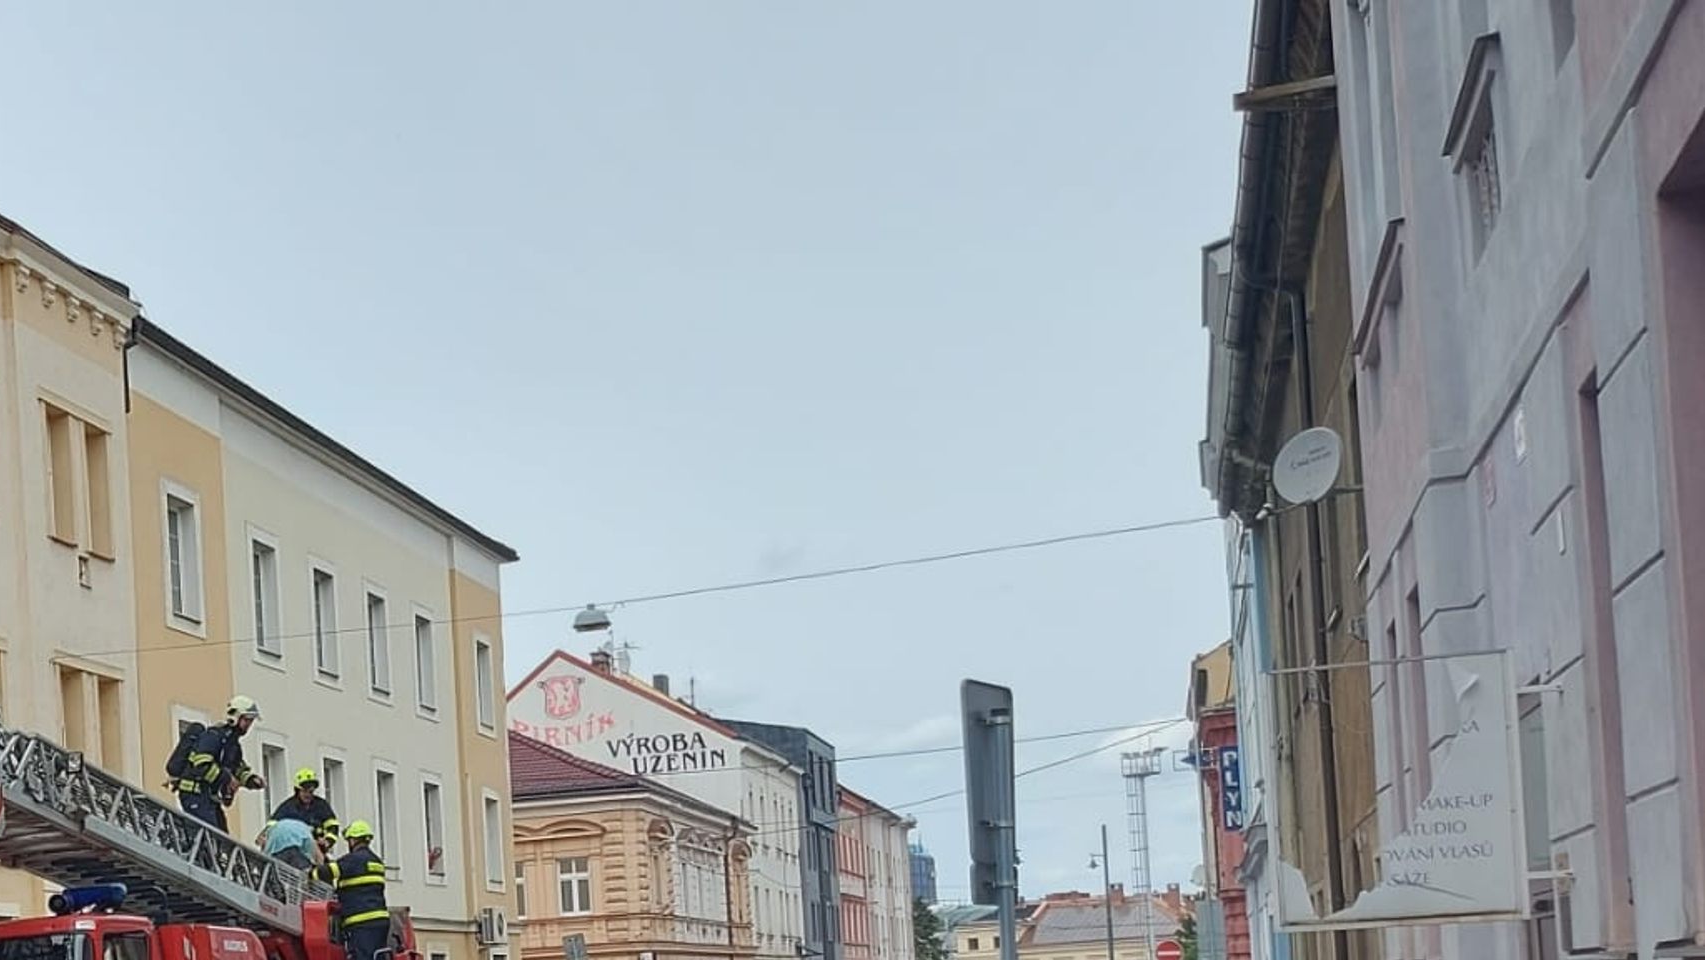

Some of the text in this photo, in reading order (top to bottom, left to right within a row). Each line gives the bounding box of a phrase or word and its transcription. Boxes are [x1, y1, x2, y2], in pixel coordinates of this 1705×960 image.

[606, 731, 707, 759] VÝROBA
[1222, 750, 1243, 828] PLYN
[1400, 819, 1468, 836] TUDIO
